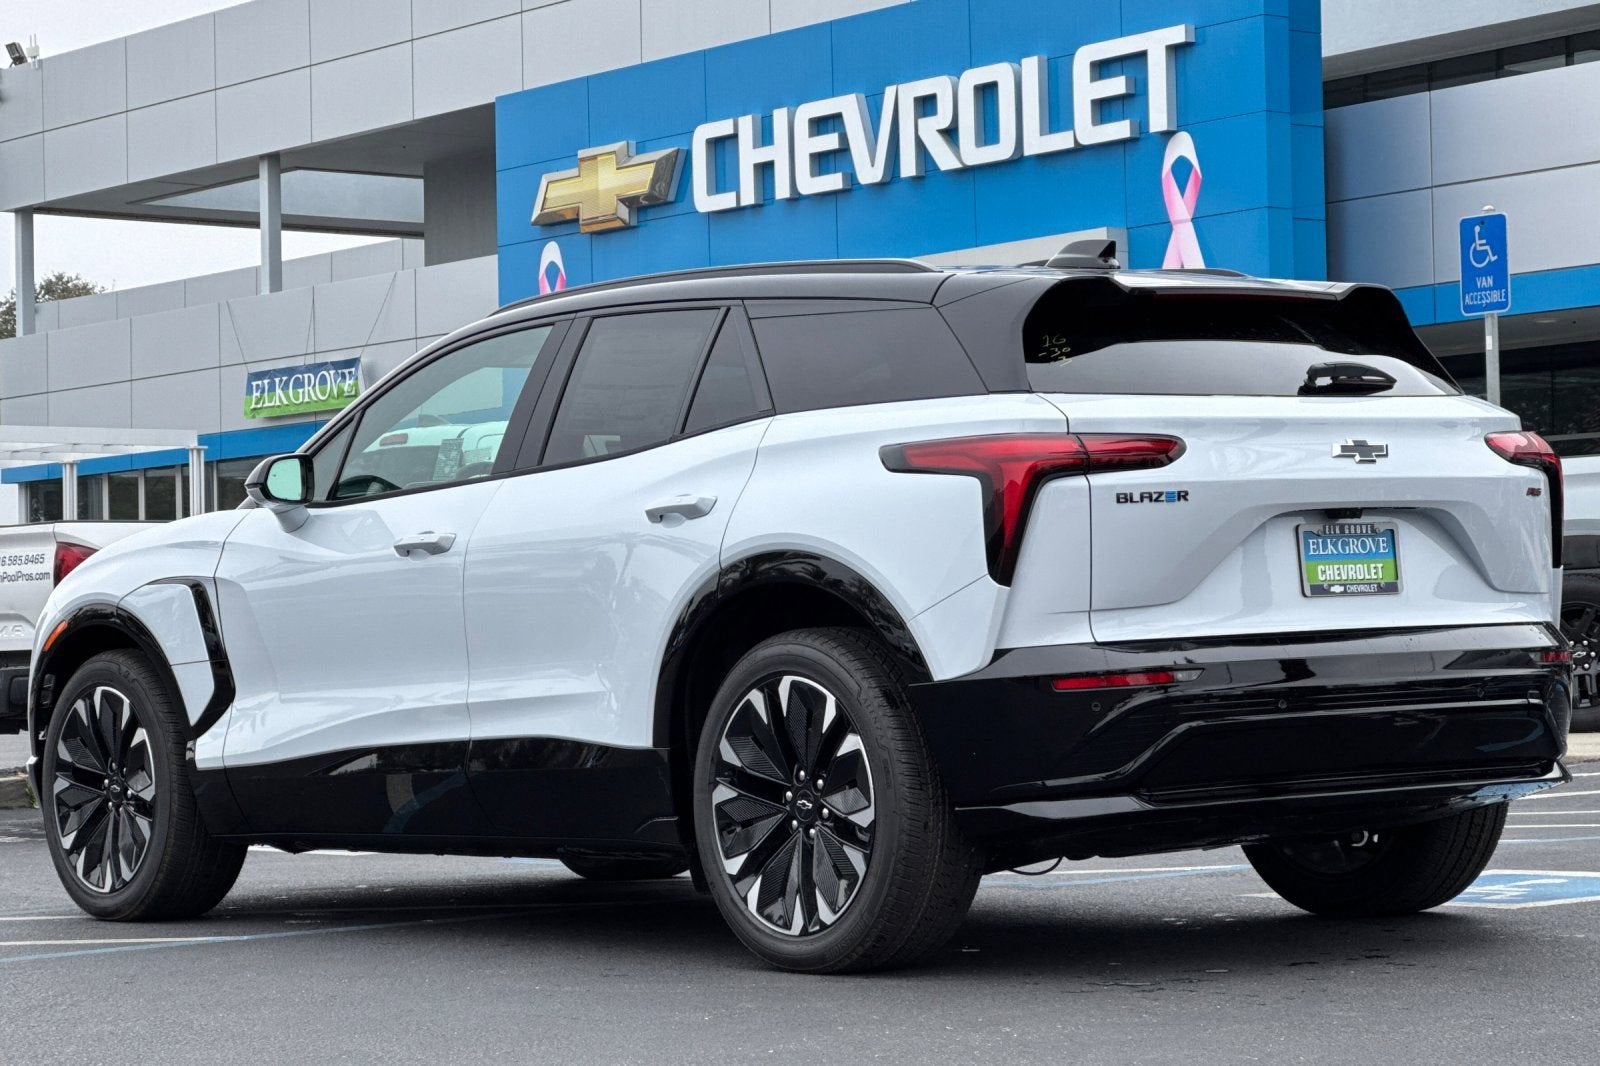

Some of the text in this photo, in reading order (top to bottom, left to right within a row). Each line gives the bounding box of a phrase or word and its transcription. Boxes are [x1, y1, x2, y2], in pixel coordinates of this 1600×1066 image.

[692, 23, 1195, 213] CHEVROLET
[1476, 275, 1494, 289] VAN
[1464, 289, 1507, 306] ACCESSIBLE
[1115, 490, 1189, 504] BLAZER
[1325, 524, 1372, 534] ELK GROVE
[0, 554, 45, 566] 6.585.8465
[1317, 563, 1384, 581] CHEVROLET
[1346, 583, 1378, 593] CHEVROLET
